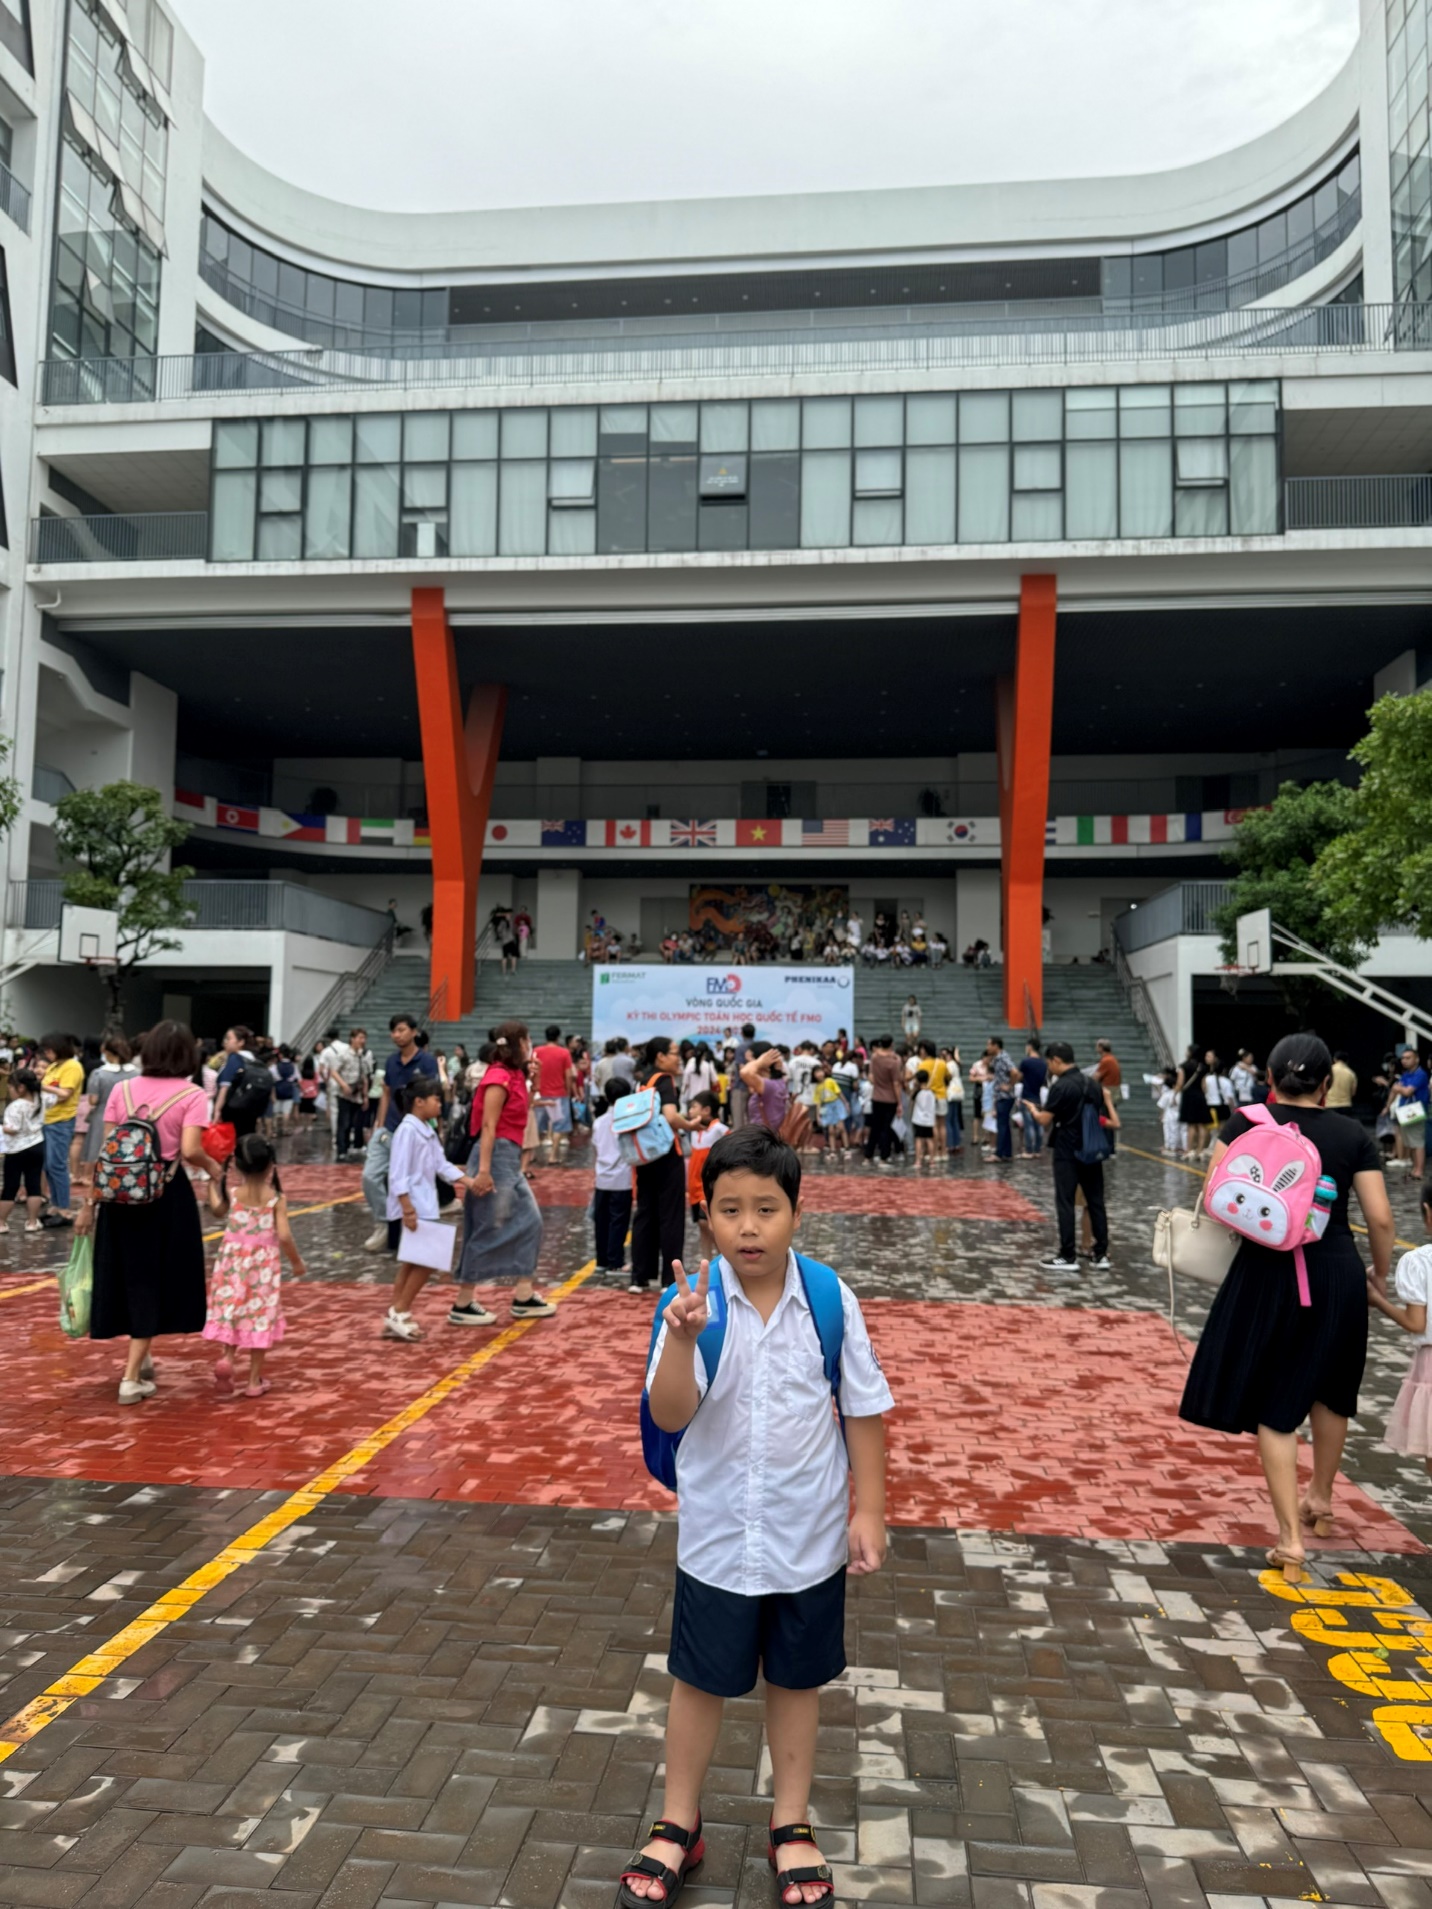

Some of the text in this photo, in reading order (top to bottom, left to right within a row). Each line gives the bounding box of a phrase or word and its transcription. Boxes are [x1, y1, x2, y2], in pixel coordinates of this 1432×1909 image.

[784, 976, 836, 984] PHENIKAA
[686, 994, 763, 1008] VÒNG QUỐC GIA
[641, 1012, 657, 1021] THI
[659, 1012, 701, 1021] OLYMPIC
[704, 1010, 730, 1021] TOÁN
[733, 1012, 753, 1023] HỌC
[755, 1010, 783, 1022] QUỐC
[785, 1009, 799, 1022] TẾ
[800, 1013, 822, 1022] FMO
[696, 1025, 721, 1035] 2024
